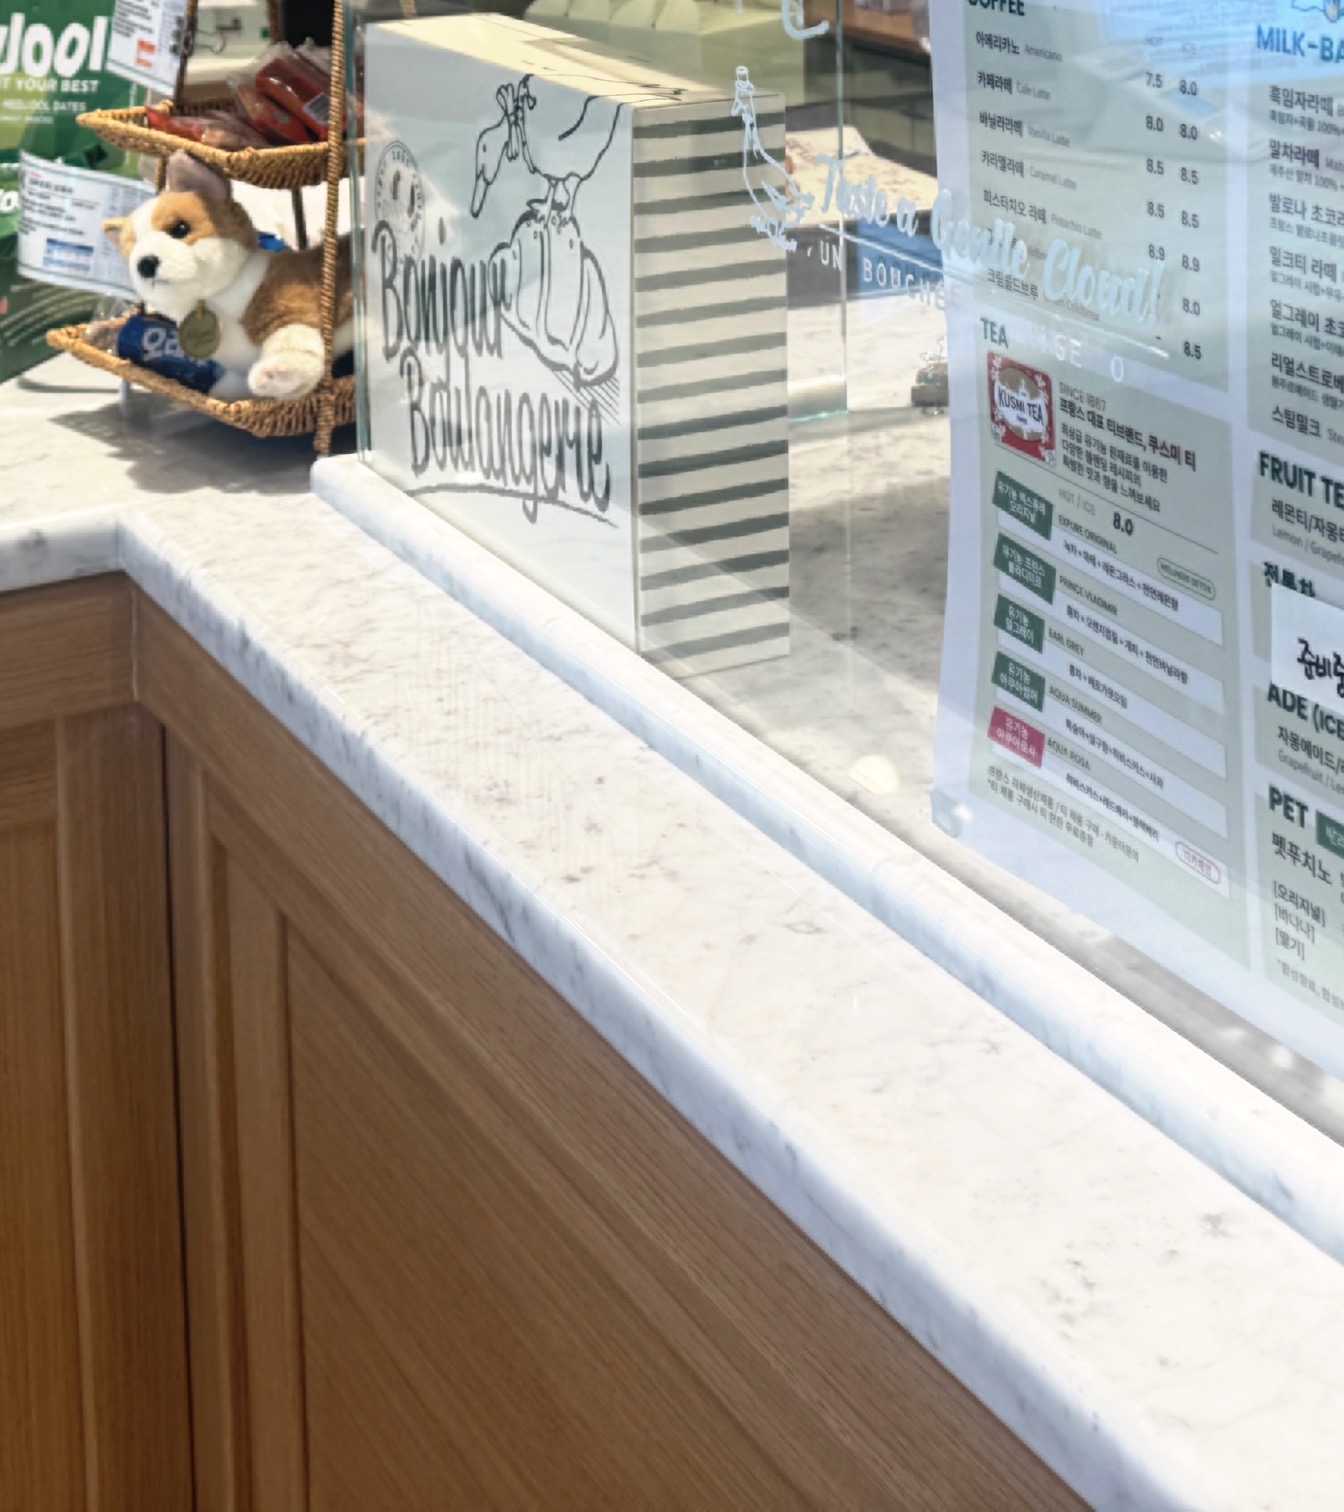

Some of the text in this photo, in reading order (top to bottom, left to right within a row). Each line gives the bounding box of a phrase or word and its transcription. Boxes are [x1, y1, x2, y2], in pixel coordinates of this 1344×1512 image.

[975, 30, 1020, 56] 아메리카노
[16, 77, 56, 92] YOUR
[60, 79, 100, 94] BEST
[1268, 84, 1334, 117] 흑임자라떼
[1268, 138, 1320, 170] 말차라떼
[1268, 191, 1307, 221] 발로나
[816, 154, 890, 226] Taste
[897, 198, 920, 238] a
[1042, 239, 1166, 324] Cloud!
[1269, 245, 1338, 284] 밀크티 라떼
[372, 216, 513, 386] Bonjour
[1269, 298, 1320, 332] 얼그레이
[980, 317, 1009, 349] TEA
[400, 348, 612, 524] Boulangerie
[1270, 404, 1322, 439] 스팀밀크
[1258, 450, 1317, 497] FRUIT
[1268, 684, 1309, 722] ADE
[1268, 782, 1309, 830] PET
[1271, 832, 1334, 887] 펫푸치노
